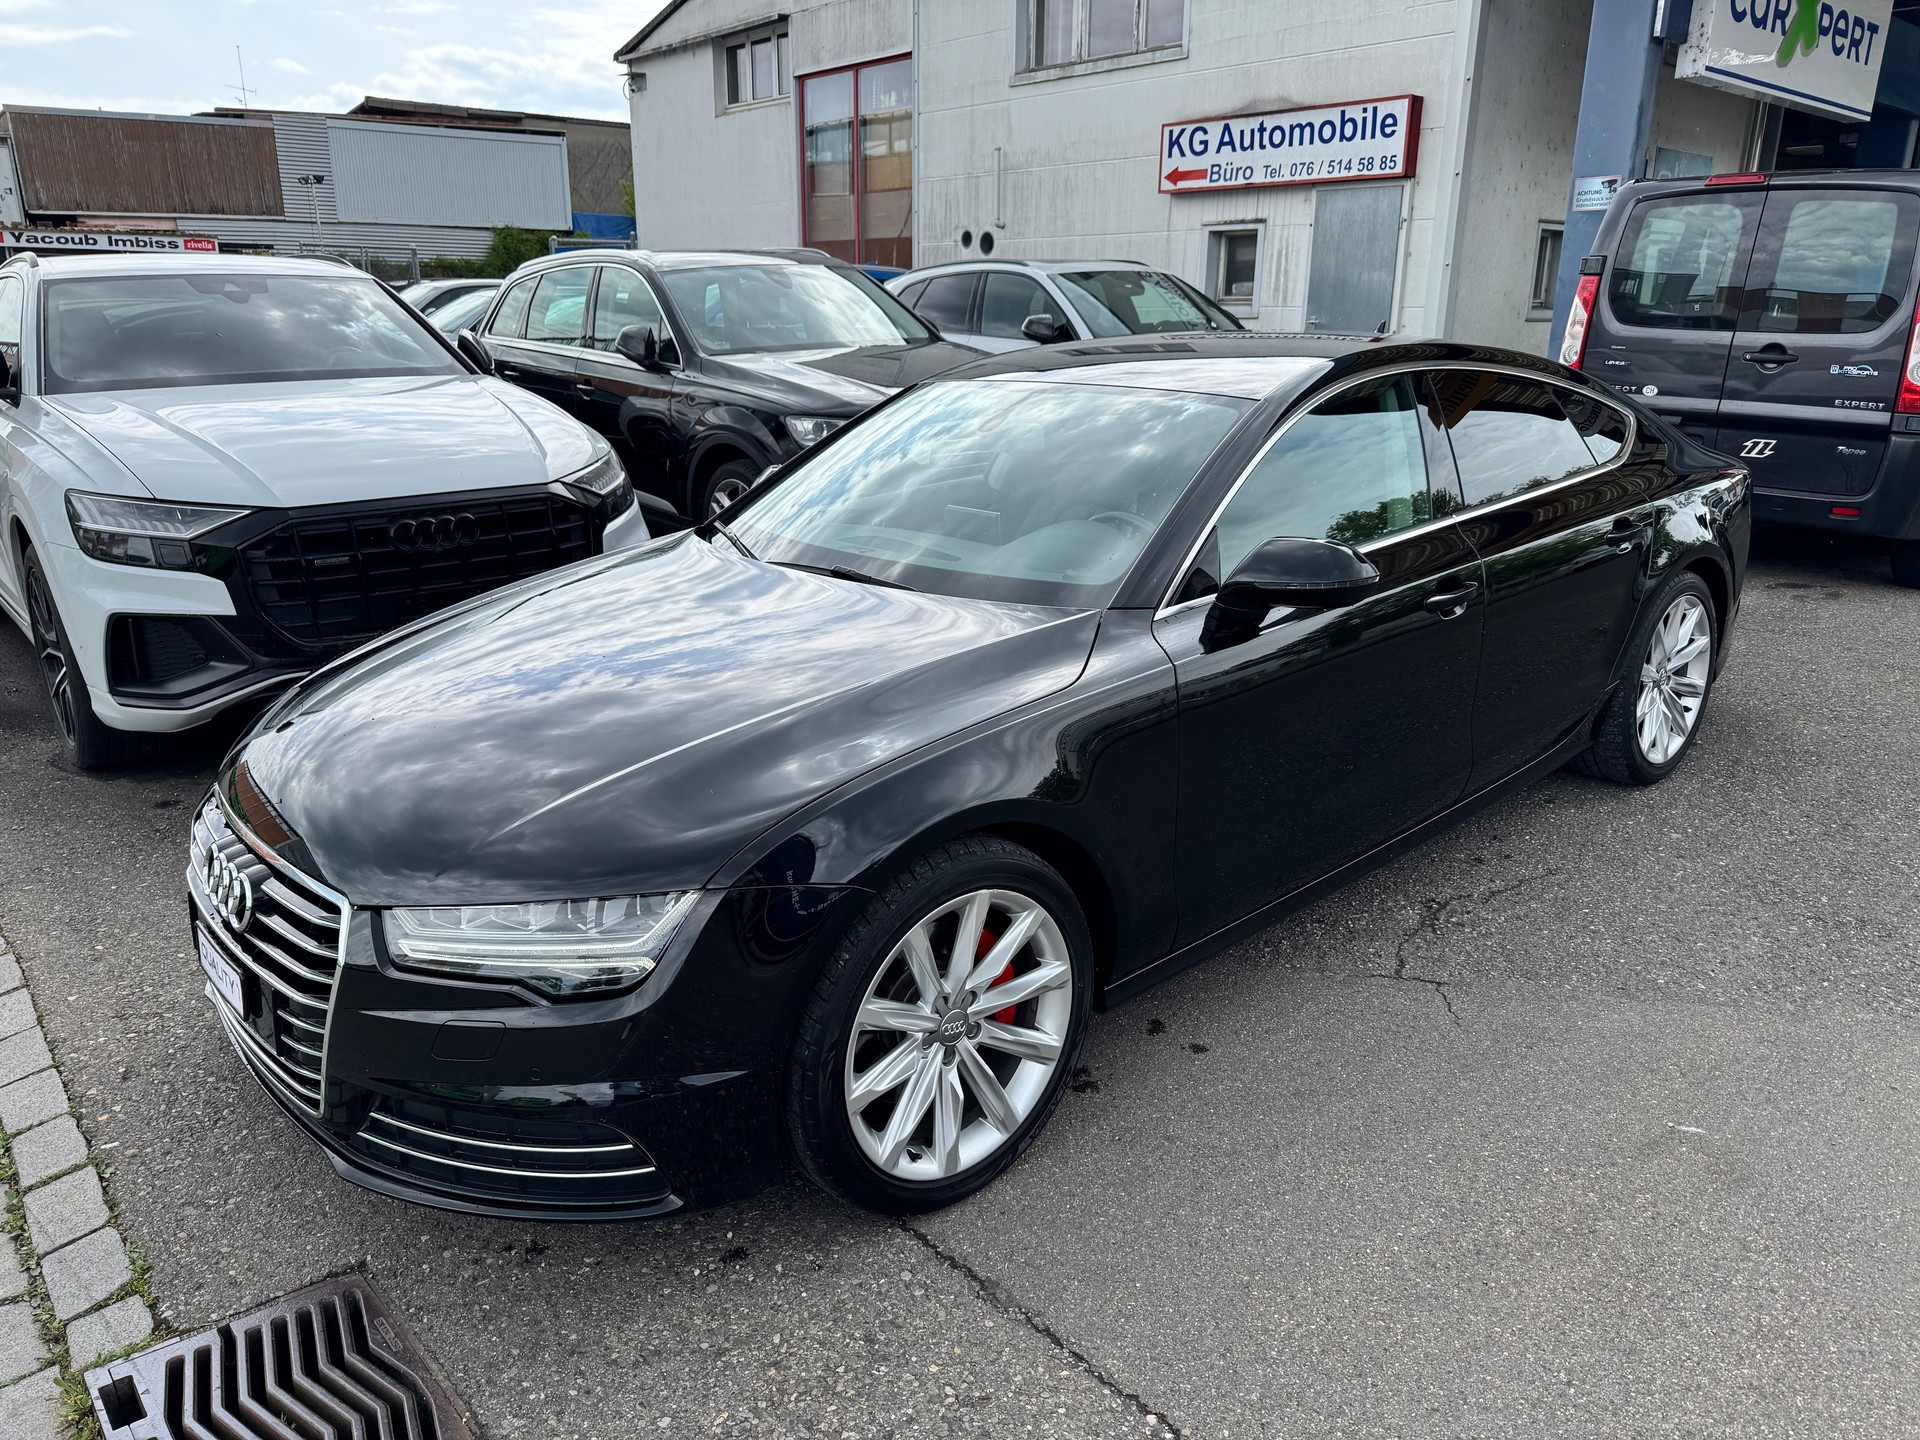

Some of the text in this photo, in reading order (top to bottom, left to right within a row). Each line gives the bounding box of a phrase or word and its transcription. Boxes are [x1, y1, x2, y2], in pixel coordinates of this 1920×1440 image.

[1167, 105, 1398, 159] KG Automobile
[1209, 163, 1254, 183] Büro
[1263, 164, 1285, 180] Tel.
[1290, 162, 1314, 177] 076
[1327, 158, 1352, 174] 514
[1357, 156, 1374, 172] 58
[1379, 154, 1397, 171] 85
[9, 231, 179, 249] Yacoub Imbiss
[187, 241, 214, 249] rivella
[1645, 387, 1655, 395] CH
[1834, 399, 1886, 410] EXPERT
[201, 942, 235, 994] QUALITY
